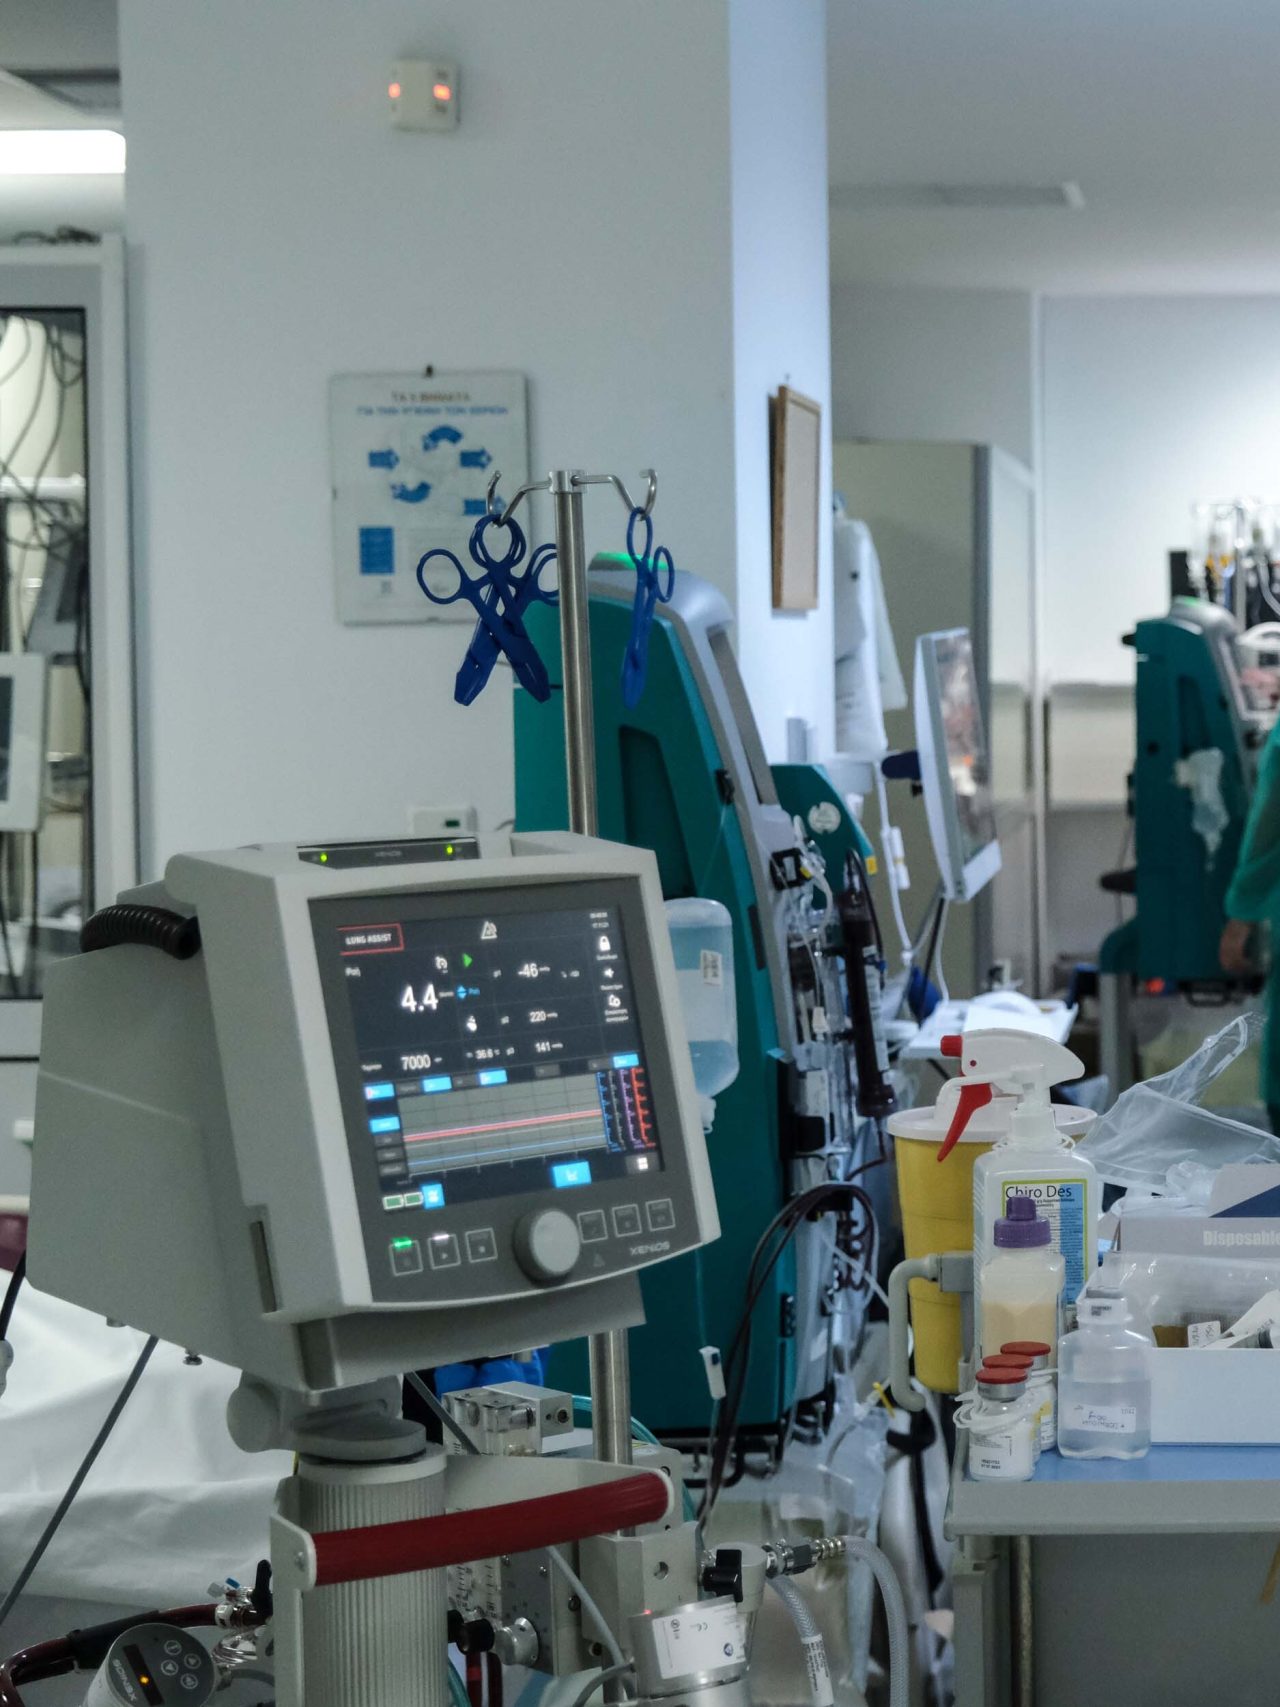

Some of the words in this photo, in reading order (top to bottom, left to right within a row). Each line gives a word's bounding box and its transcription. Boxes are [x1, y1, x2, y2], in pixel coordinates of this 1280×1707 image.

[345, 935, 367, 945] LUNG
[367, 933, 392, 943] ASSIST
[518, 963, 539, 978] -46
[401, 983, 439, 1012] 4.4
[529, 1011, 546, 1023] 220
[535, 1042, 551, 1053] 141
[401, 1054, 431, 1071] 7000
[1005, 1186, 1042, 1199] Chiro
[1046, 1185, 1072, 1198] Des
[629, 1241, 671, 1256] XENIOS
